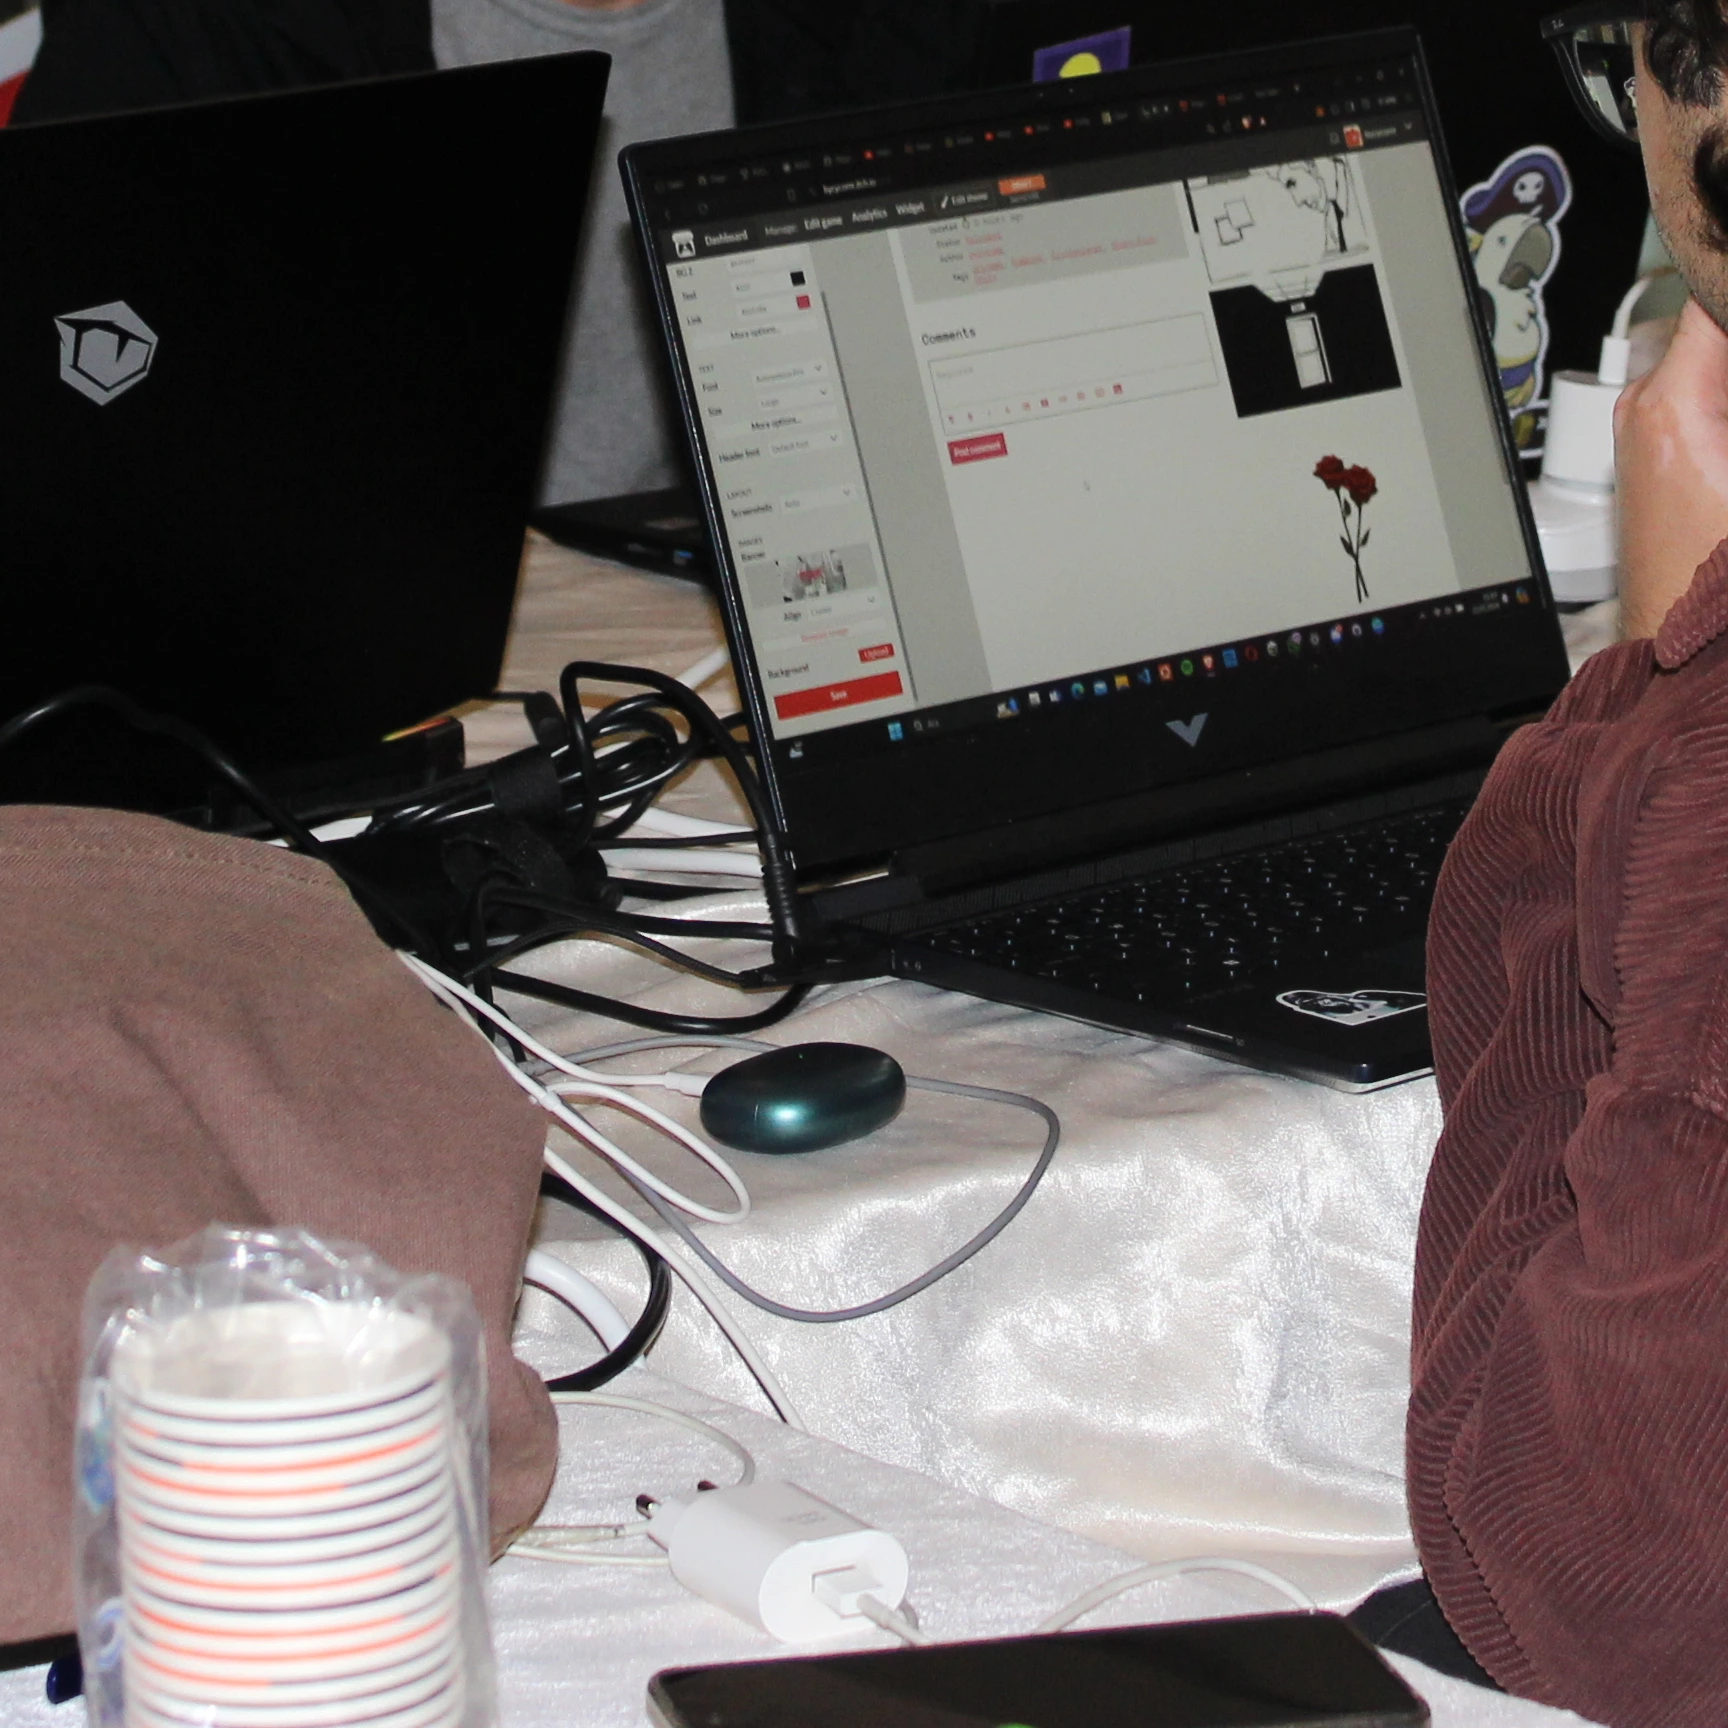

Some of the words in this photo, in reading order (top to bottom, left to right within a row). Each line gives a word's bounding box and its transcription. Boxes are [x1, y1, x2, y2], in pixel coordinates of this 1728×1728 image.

[852, 207, 888, 223] Analytics
[895, 201, 925, 216] Widget
[804, 217, 821, 231] Edit
[704, 229, 749, 247] Dashboard
[921, 326, 977, 347] Comments
